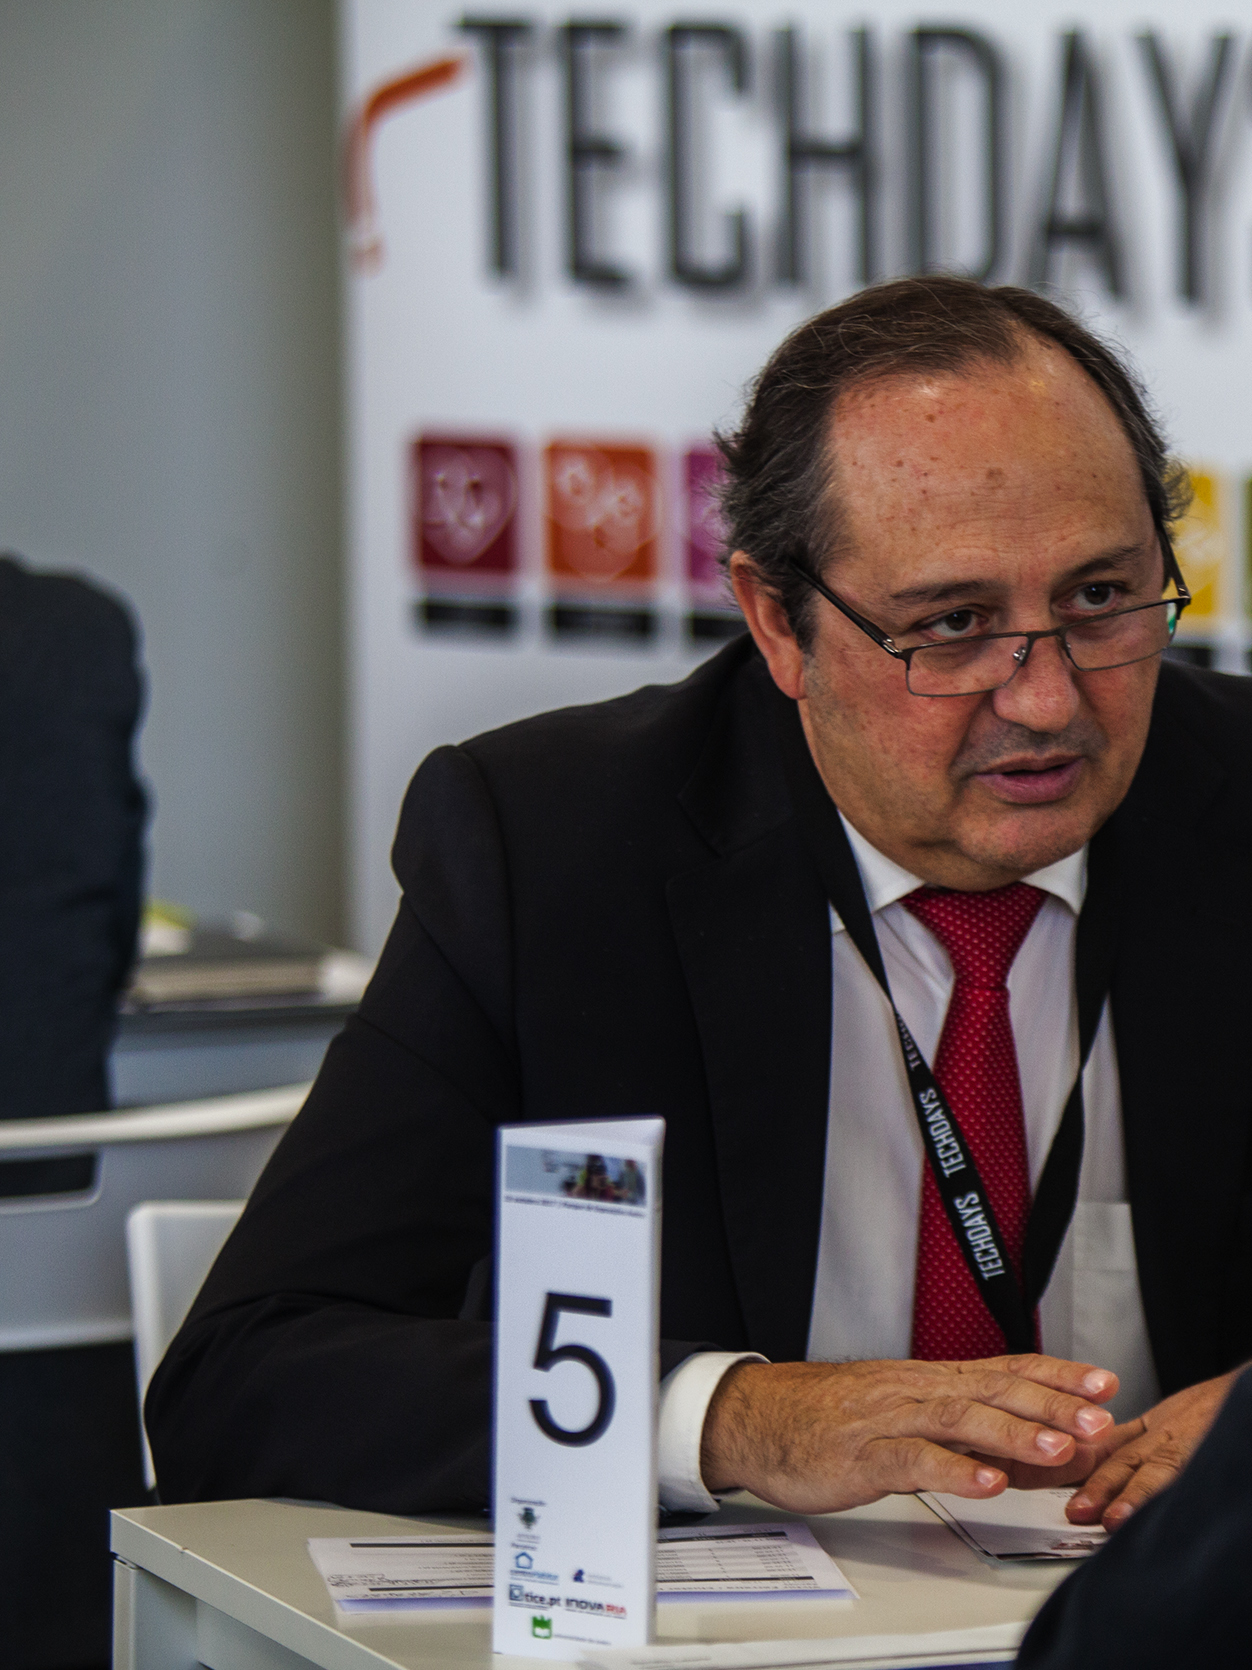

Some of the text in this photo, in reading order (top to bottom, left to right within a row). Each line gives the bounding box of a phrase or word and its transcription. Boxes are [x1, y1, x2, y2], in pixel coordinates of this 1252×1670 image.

[919, 1087, 967, 1178] TECHDAYS
[953, 1191, 1006, 1281] TECHDAYS
[528, 1291, 617, 1448] 5
